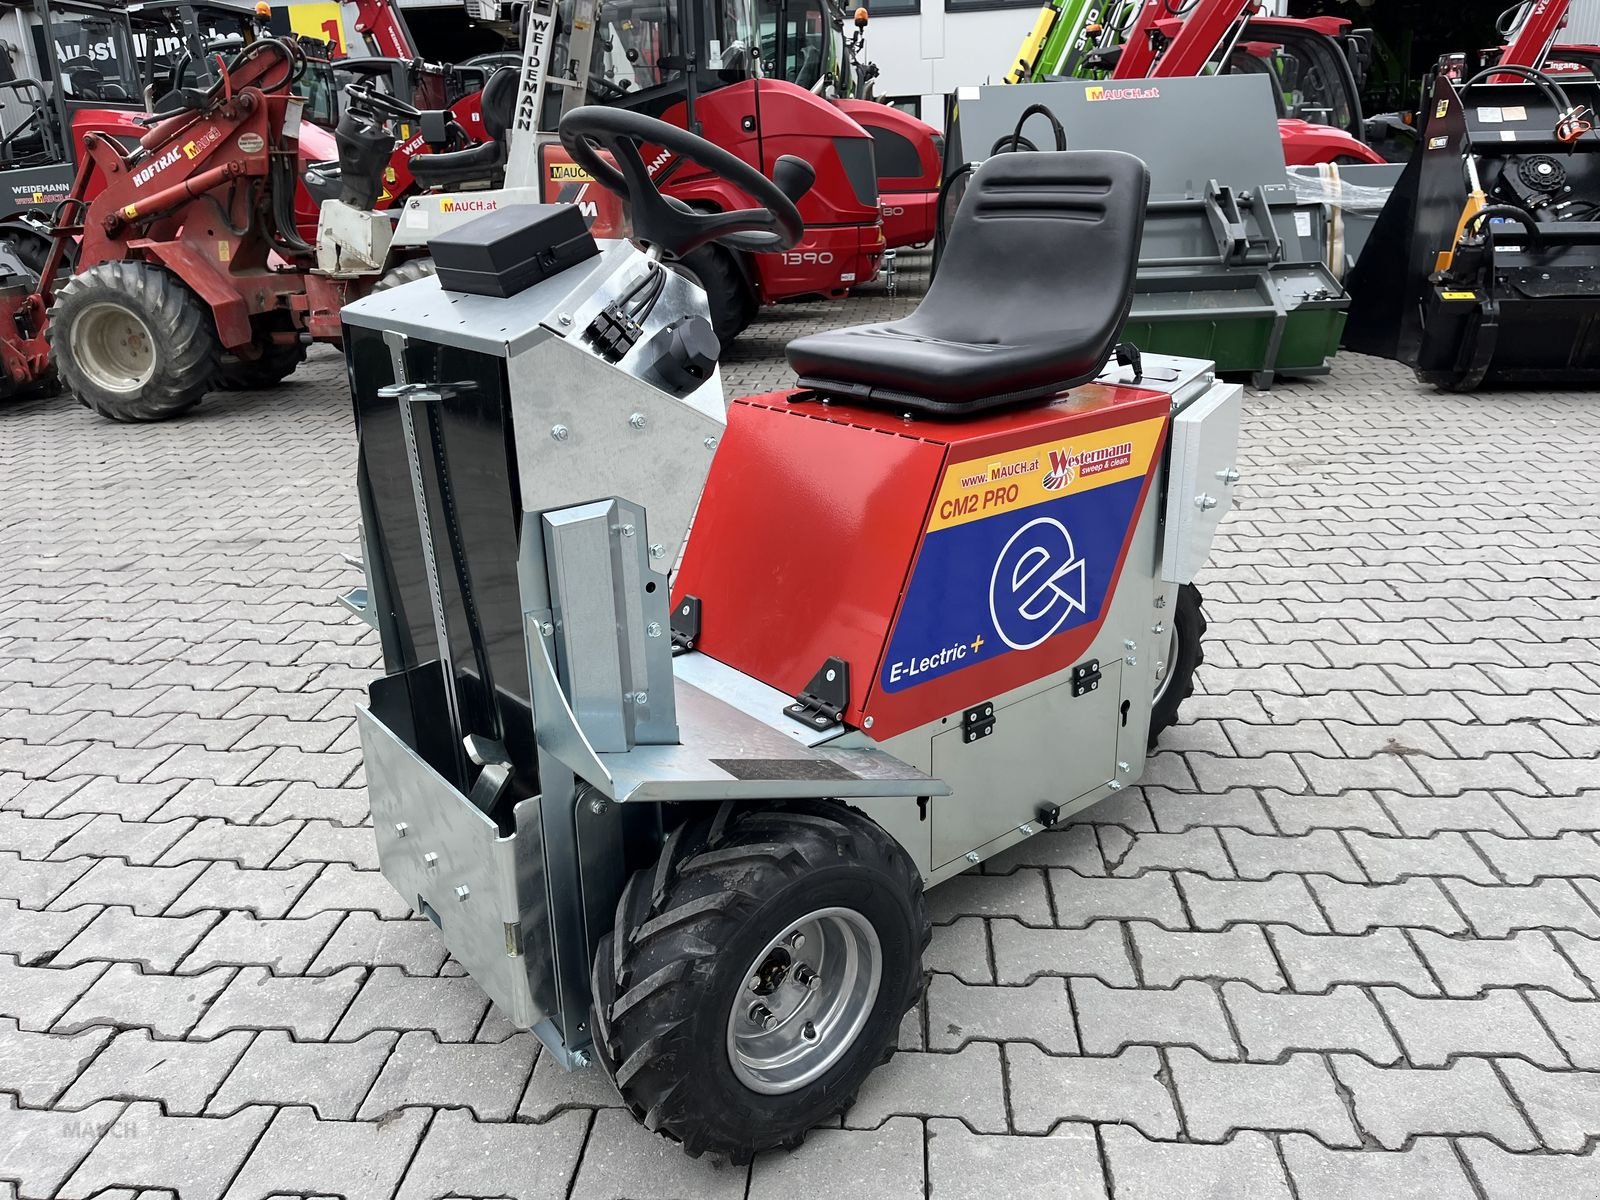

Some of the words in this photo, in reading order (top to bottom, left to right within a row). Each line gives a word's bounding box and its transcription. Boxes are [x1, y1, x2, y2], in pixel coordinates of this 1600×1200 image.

[321, 20, 347, 60] 1
[517, 18, 549, 131] WEIDEMANN
[1090, 88, 1160, 101] MAUCH.at
[188, 126, 222, 157] MAUCH
[132, 145, 182, 188] HOFTRAC
[12, 183, 70, 194] WEIDEMANN
[443, 200, 497, 213] MAUCH.at
[781, 252, 834, 265] 1390
[1048, 442, 1132, 475] Westermann
[1081, 462, 1104, 475] sweep
[1104, 460, 1110, 469] &
[940, 494, 978, 520] CM2
[983, 484, 1019, 509] PRO
[889, 642, 967, 683] E-Lectric
